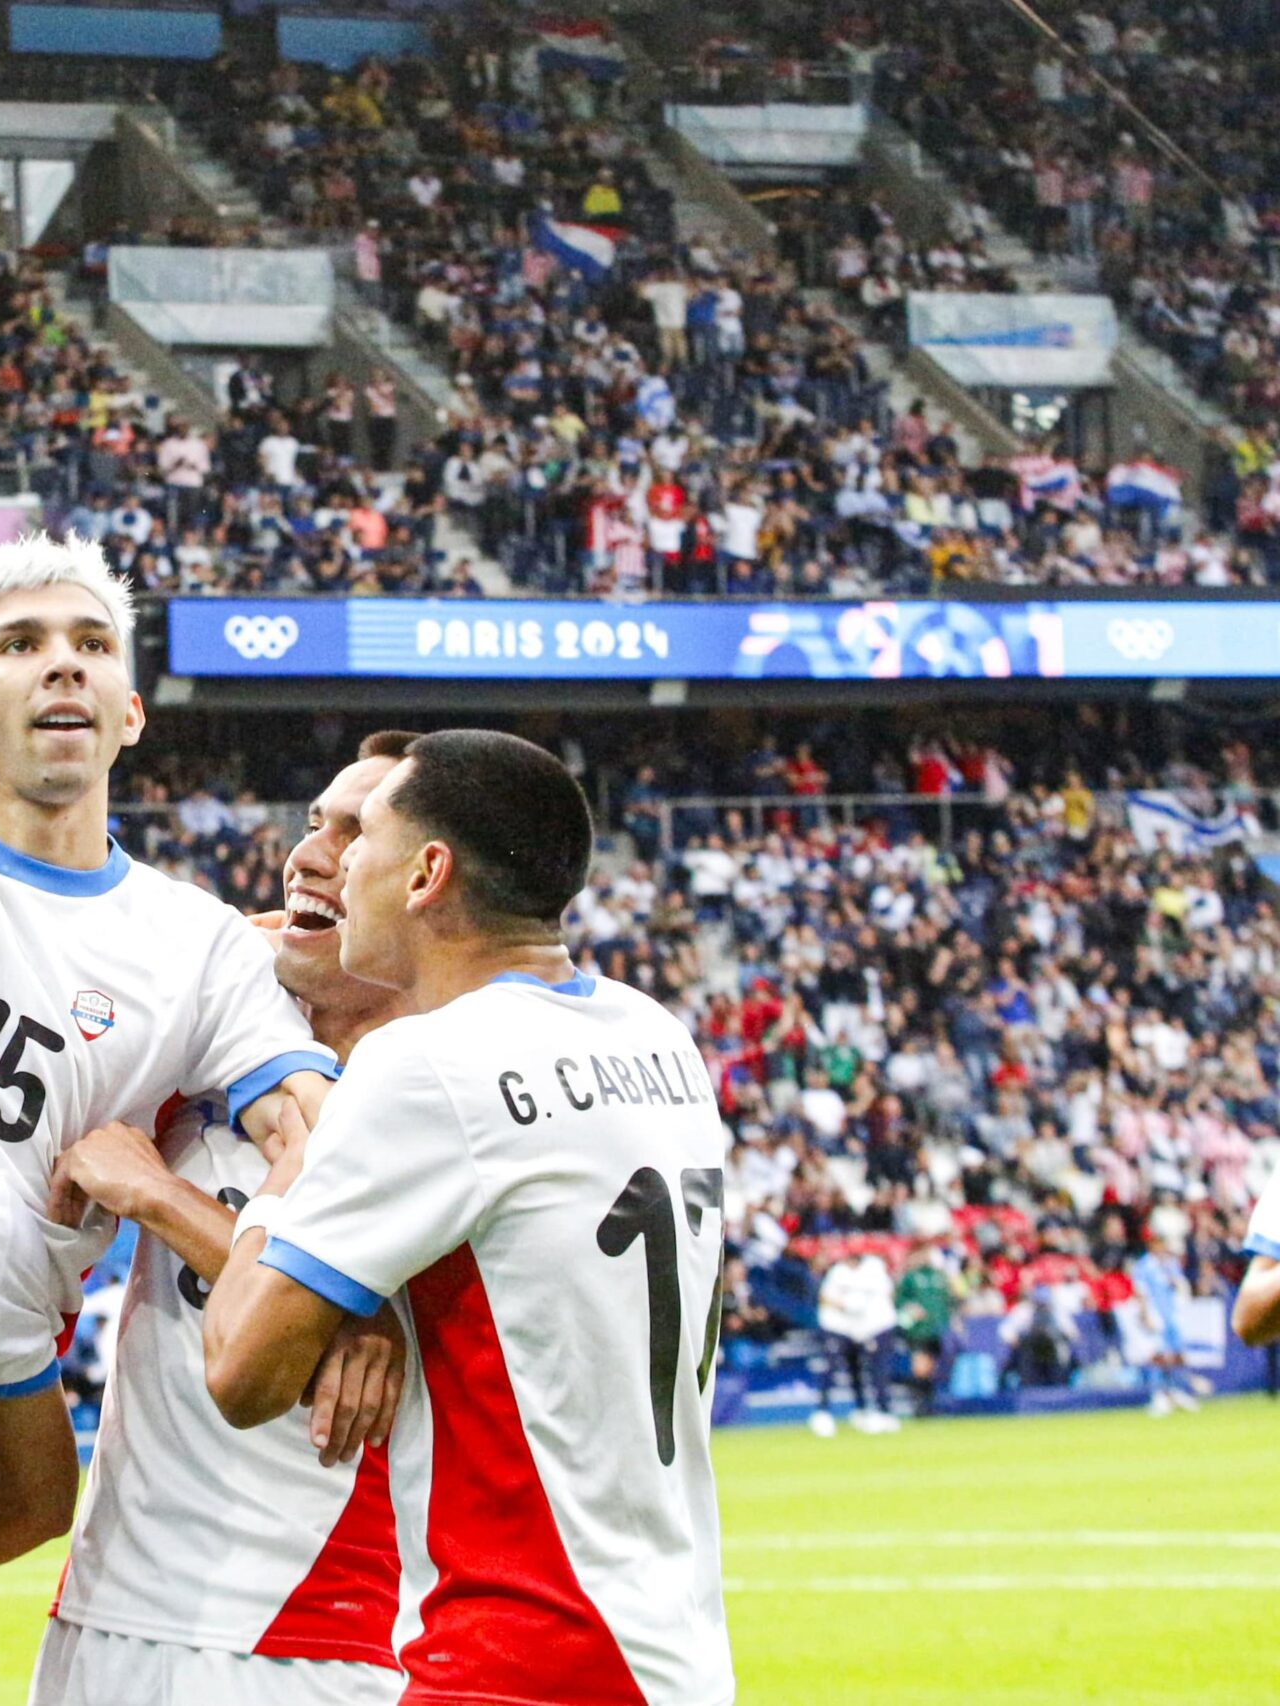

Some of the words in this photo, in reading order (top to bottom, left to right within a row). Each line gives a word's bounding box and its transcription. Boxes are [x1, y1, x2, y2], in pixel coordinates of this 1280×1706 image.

[417, 619, 544, 659] PARIS
[554, 619, 669, 659] 2024
[498, 1070, 552, 1126] G.
